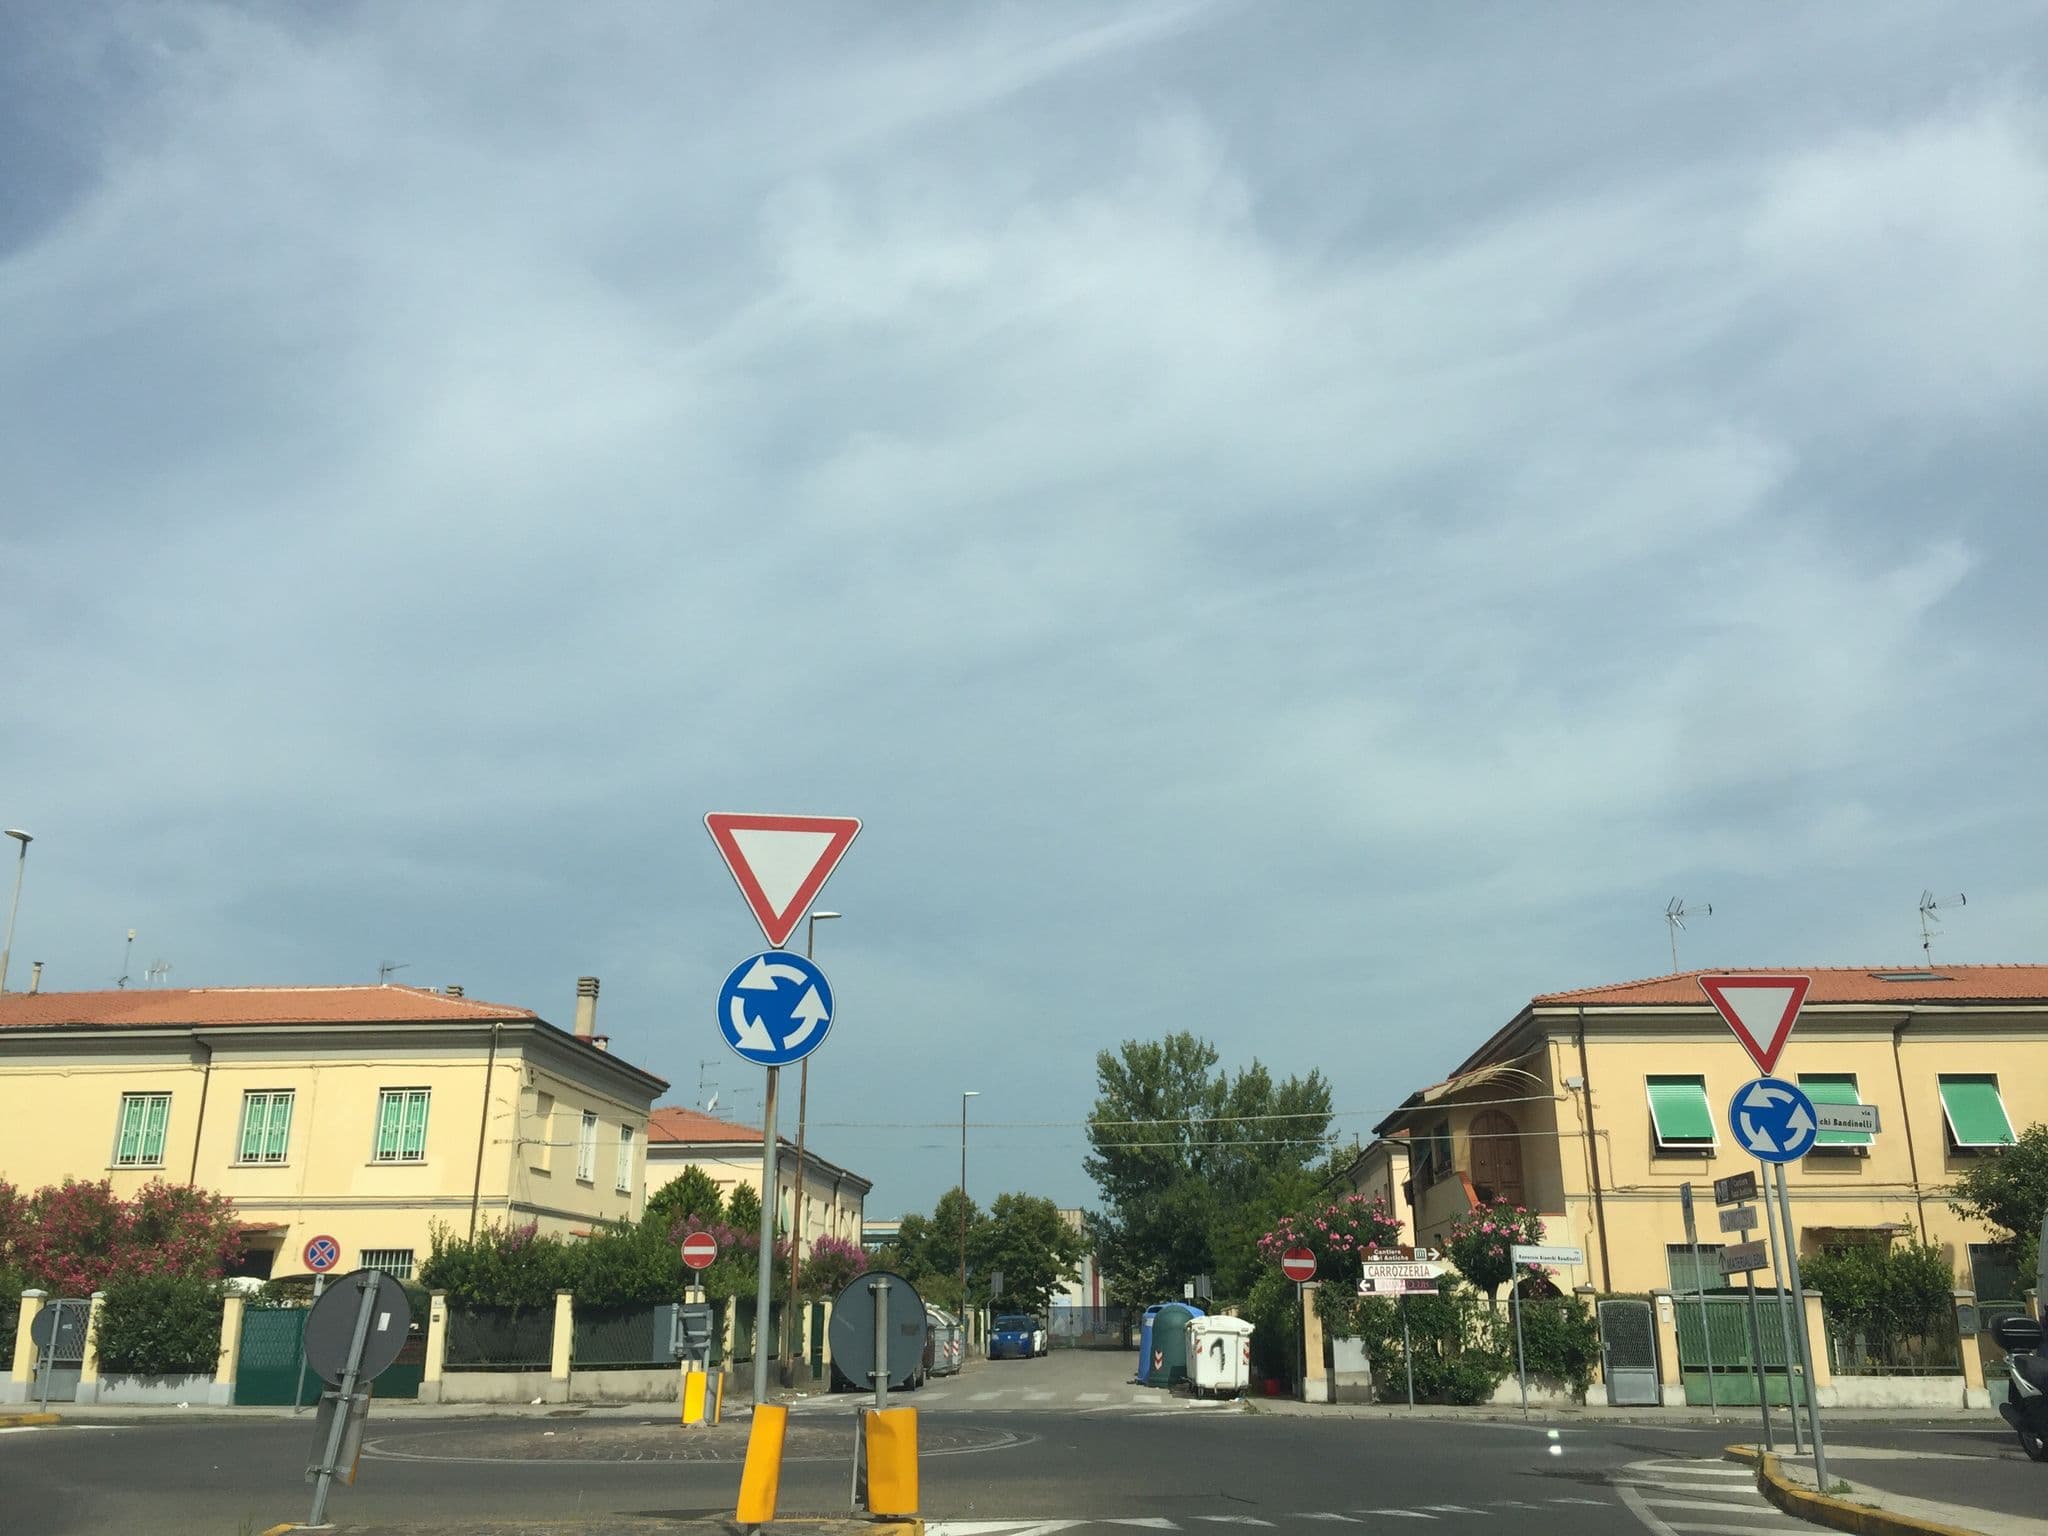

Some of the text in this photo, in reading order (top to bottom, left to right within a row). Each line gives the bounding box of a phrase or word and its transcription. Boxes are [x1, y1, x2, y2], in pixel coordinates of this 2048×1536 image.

[1819, 1118, 1872, 1129] chi Bandinelli
[1368, 1265, 1431, 1277] CARROZZERIA
